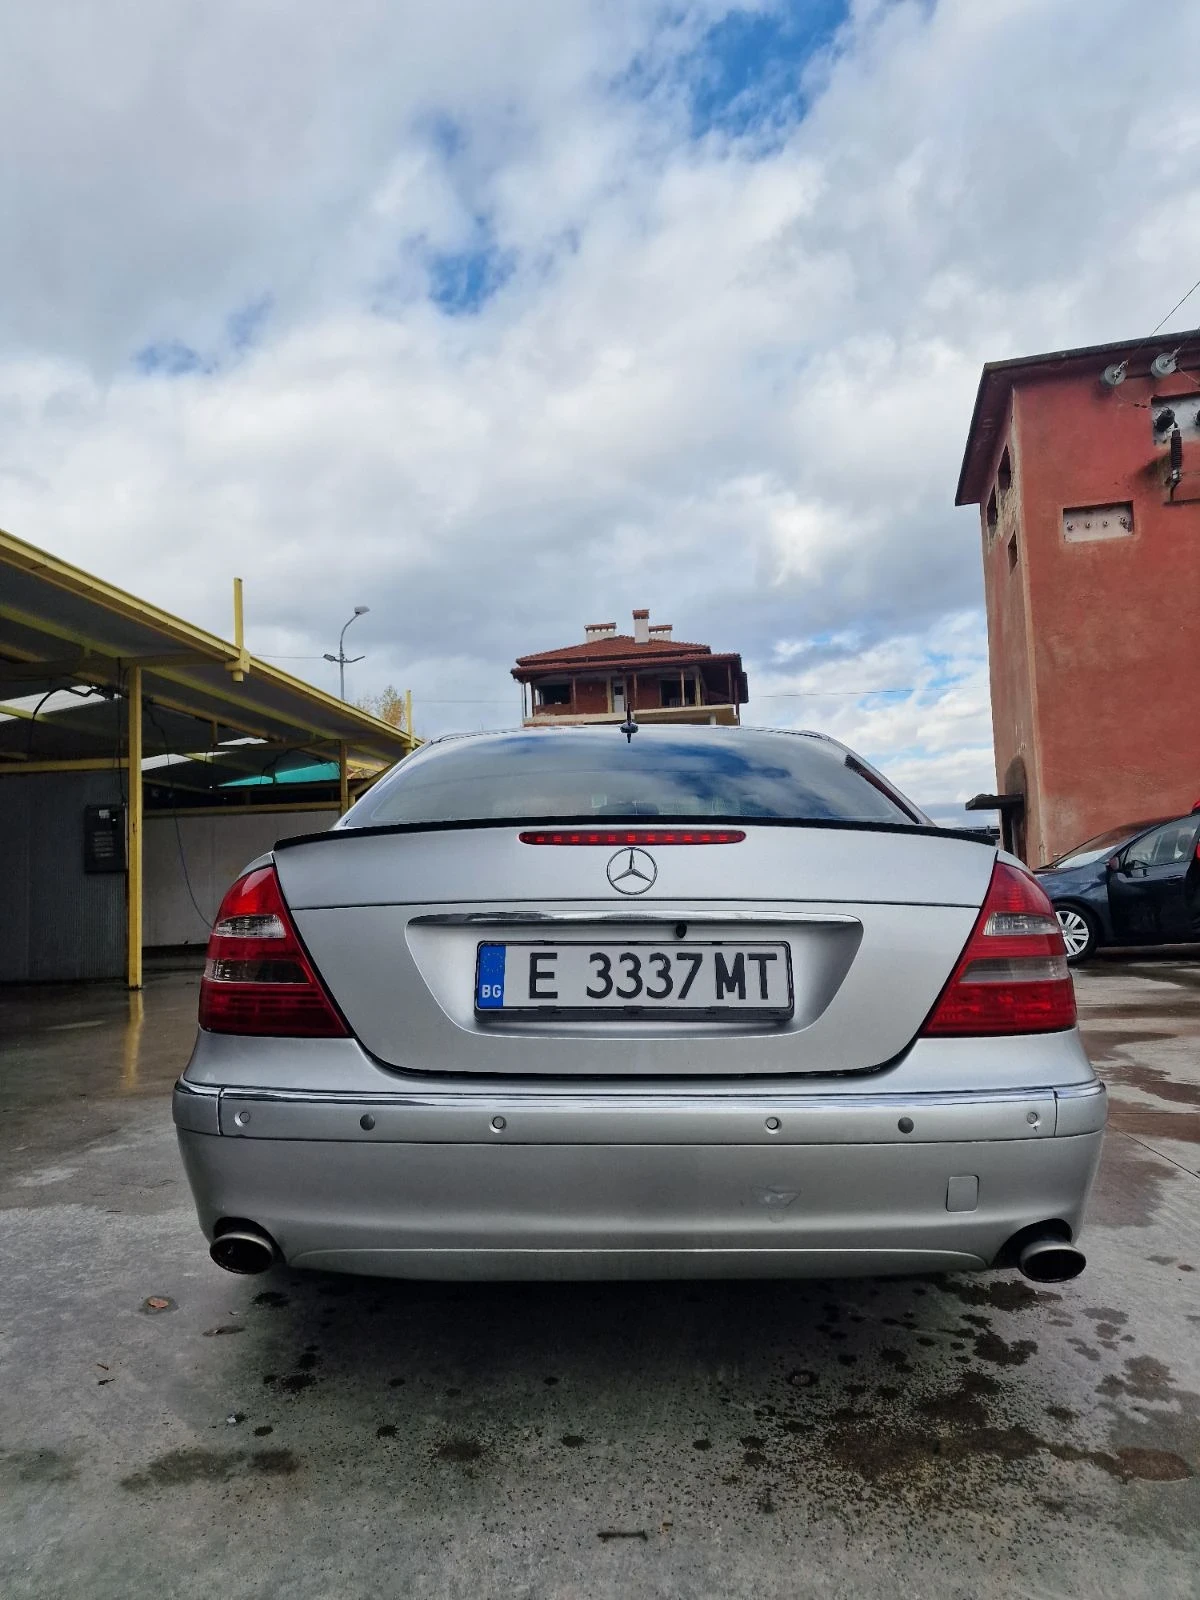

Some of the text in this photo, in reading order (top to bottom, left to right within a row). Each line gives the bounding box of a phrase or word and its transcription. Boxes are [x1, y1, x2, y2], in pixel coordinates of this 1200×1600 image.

[481, 984, 502, 999] BG
[529, 952, 777, 1000] E 3337 MT
